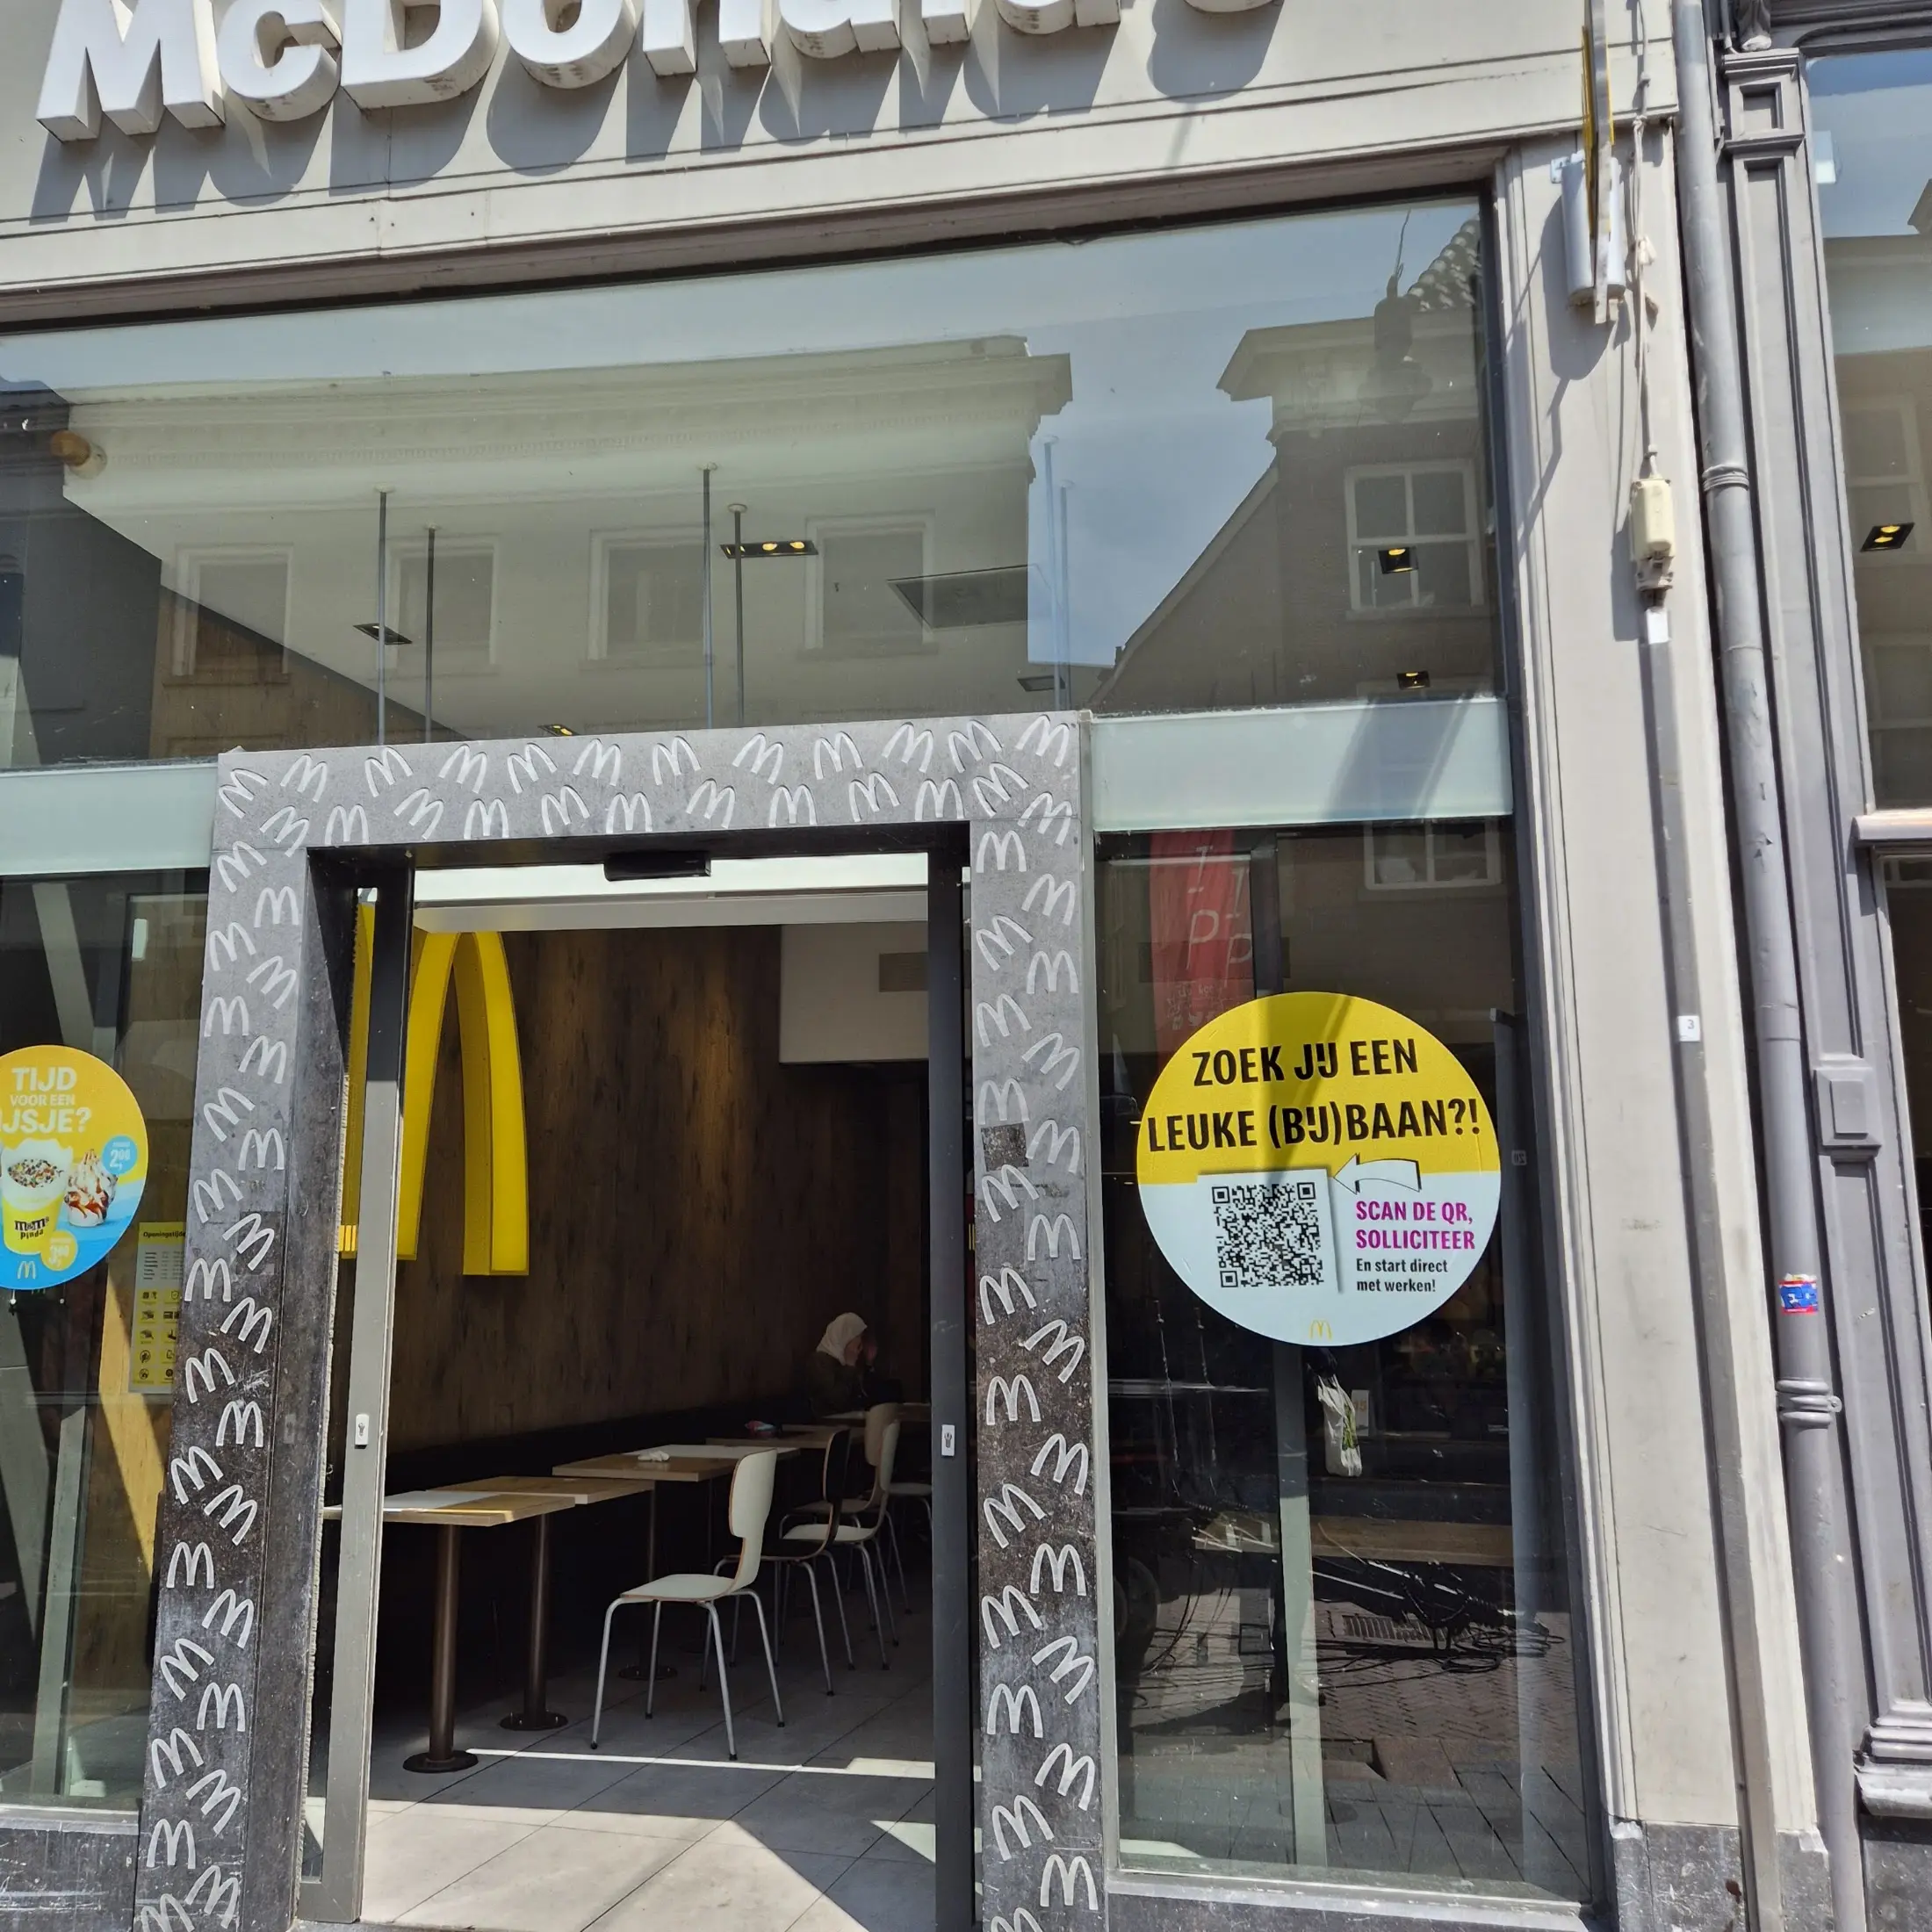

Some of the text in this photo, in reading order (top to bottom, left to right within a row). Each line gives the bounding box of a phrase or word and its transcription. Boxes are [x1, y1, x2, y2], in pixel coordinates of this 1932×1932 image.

[1687, 1019, 1695, 1029] 3
[1192, 1045, 1285, 1087] ZOEK
[1351, 1038, 1419, 1076] EEN
[11, 1066, 77, 1092] TIJD
[11, 1094, 76, 1107] VOOR EEN
[1147, 1110, 1258, 1152] LEUKE
[1356, 1200, 1473, 1224] SCAN DE QR,
[143, 1230, 186, 1239] Openingstijde
[1356, 1229, 1475, 1250] SOLLICITEER
[1356, 1258, 1448, 1273] En start direct
[1357, 1279, 1436, 1293] met werken!
